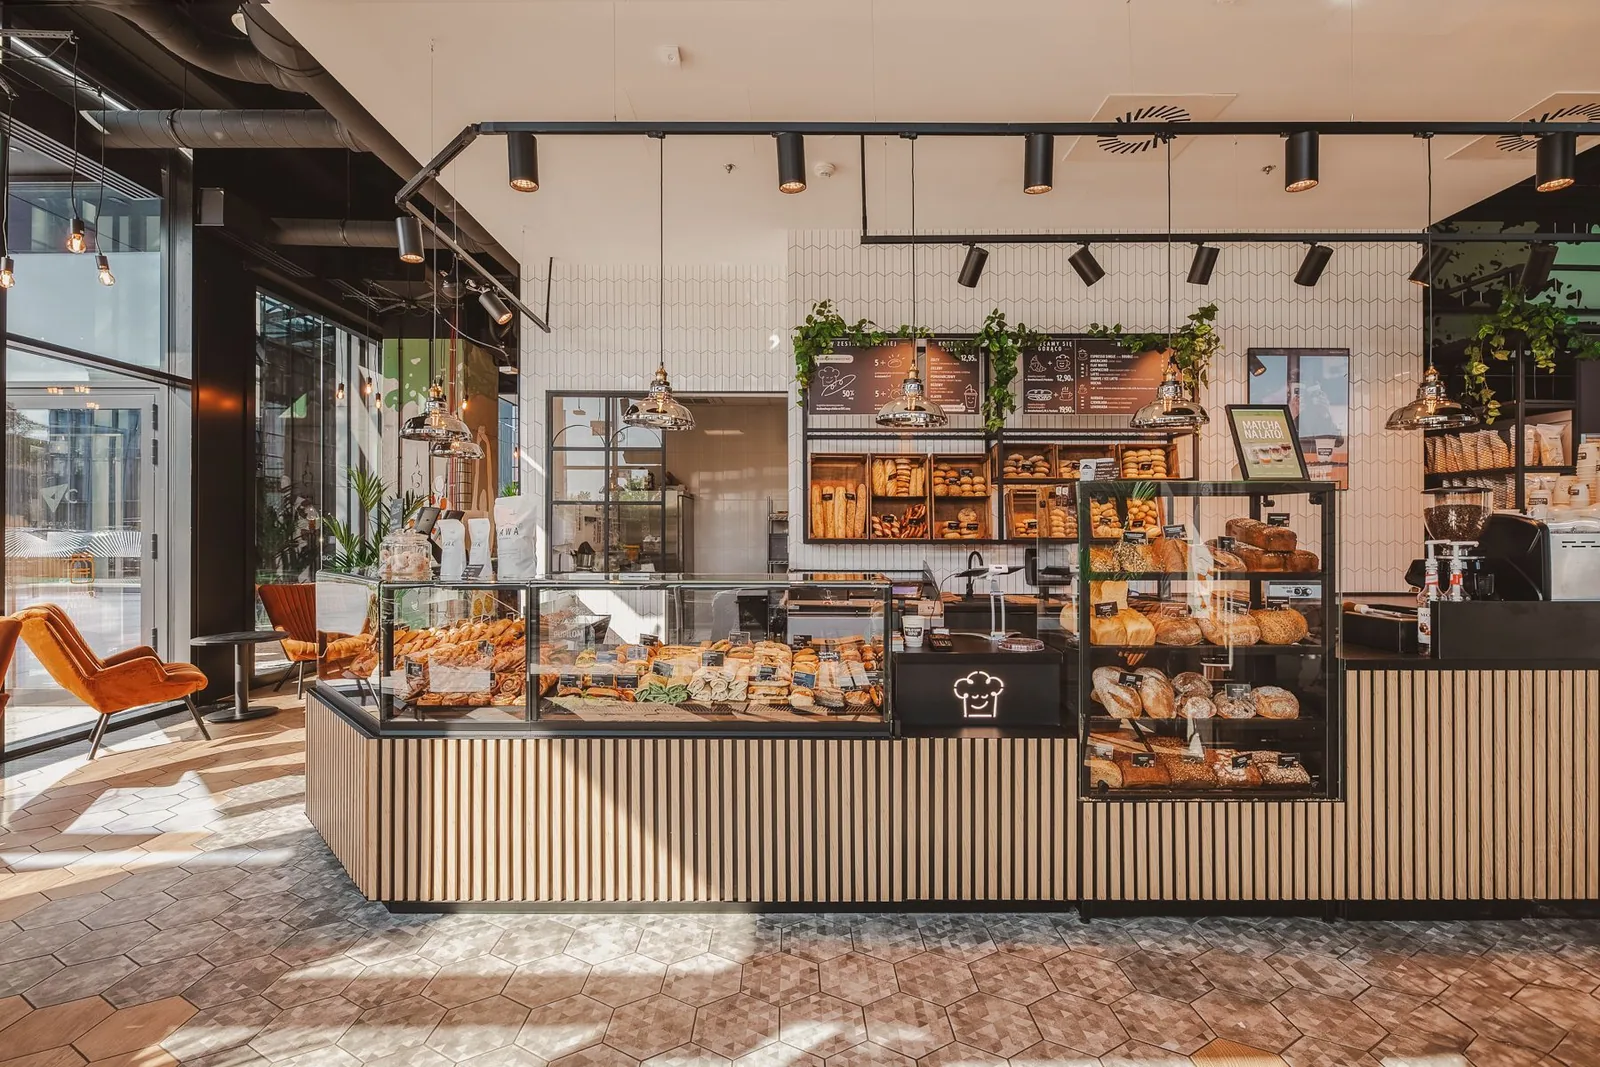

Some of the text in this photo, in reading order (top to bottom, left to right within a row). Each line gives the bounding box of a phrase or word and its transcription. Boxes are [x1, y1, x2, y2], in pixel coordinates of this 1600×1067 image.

[874, 359, 879, 367] 5
[842, 390, 855, 398] 50%
[874, 390, 879, 398] 5
[1242, 420, 1282, 430] MATCHA
[1244, 430, 1285, 439] NA LATO!
